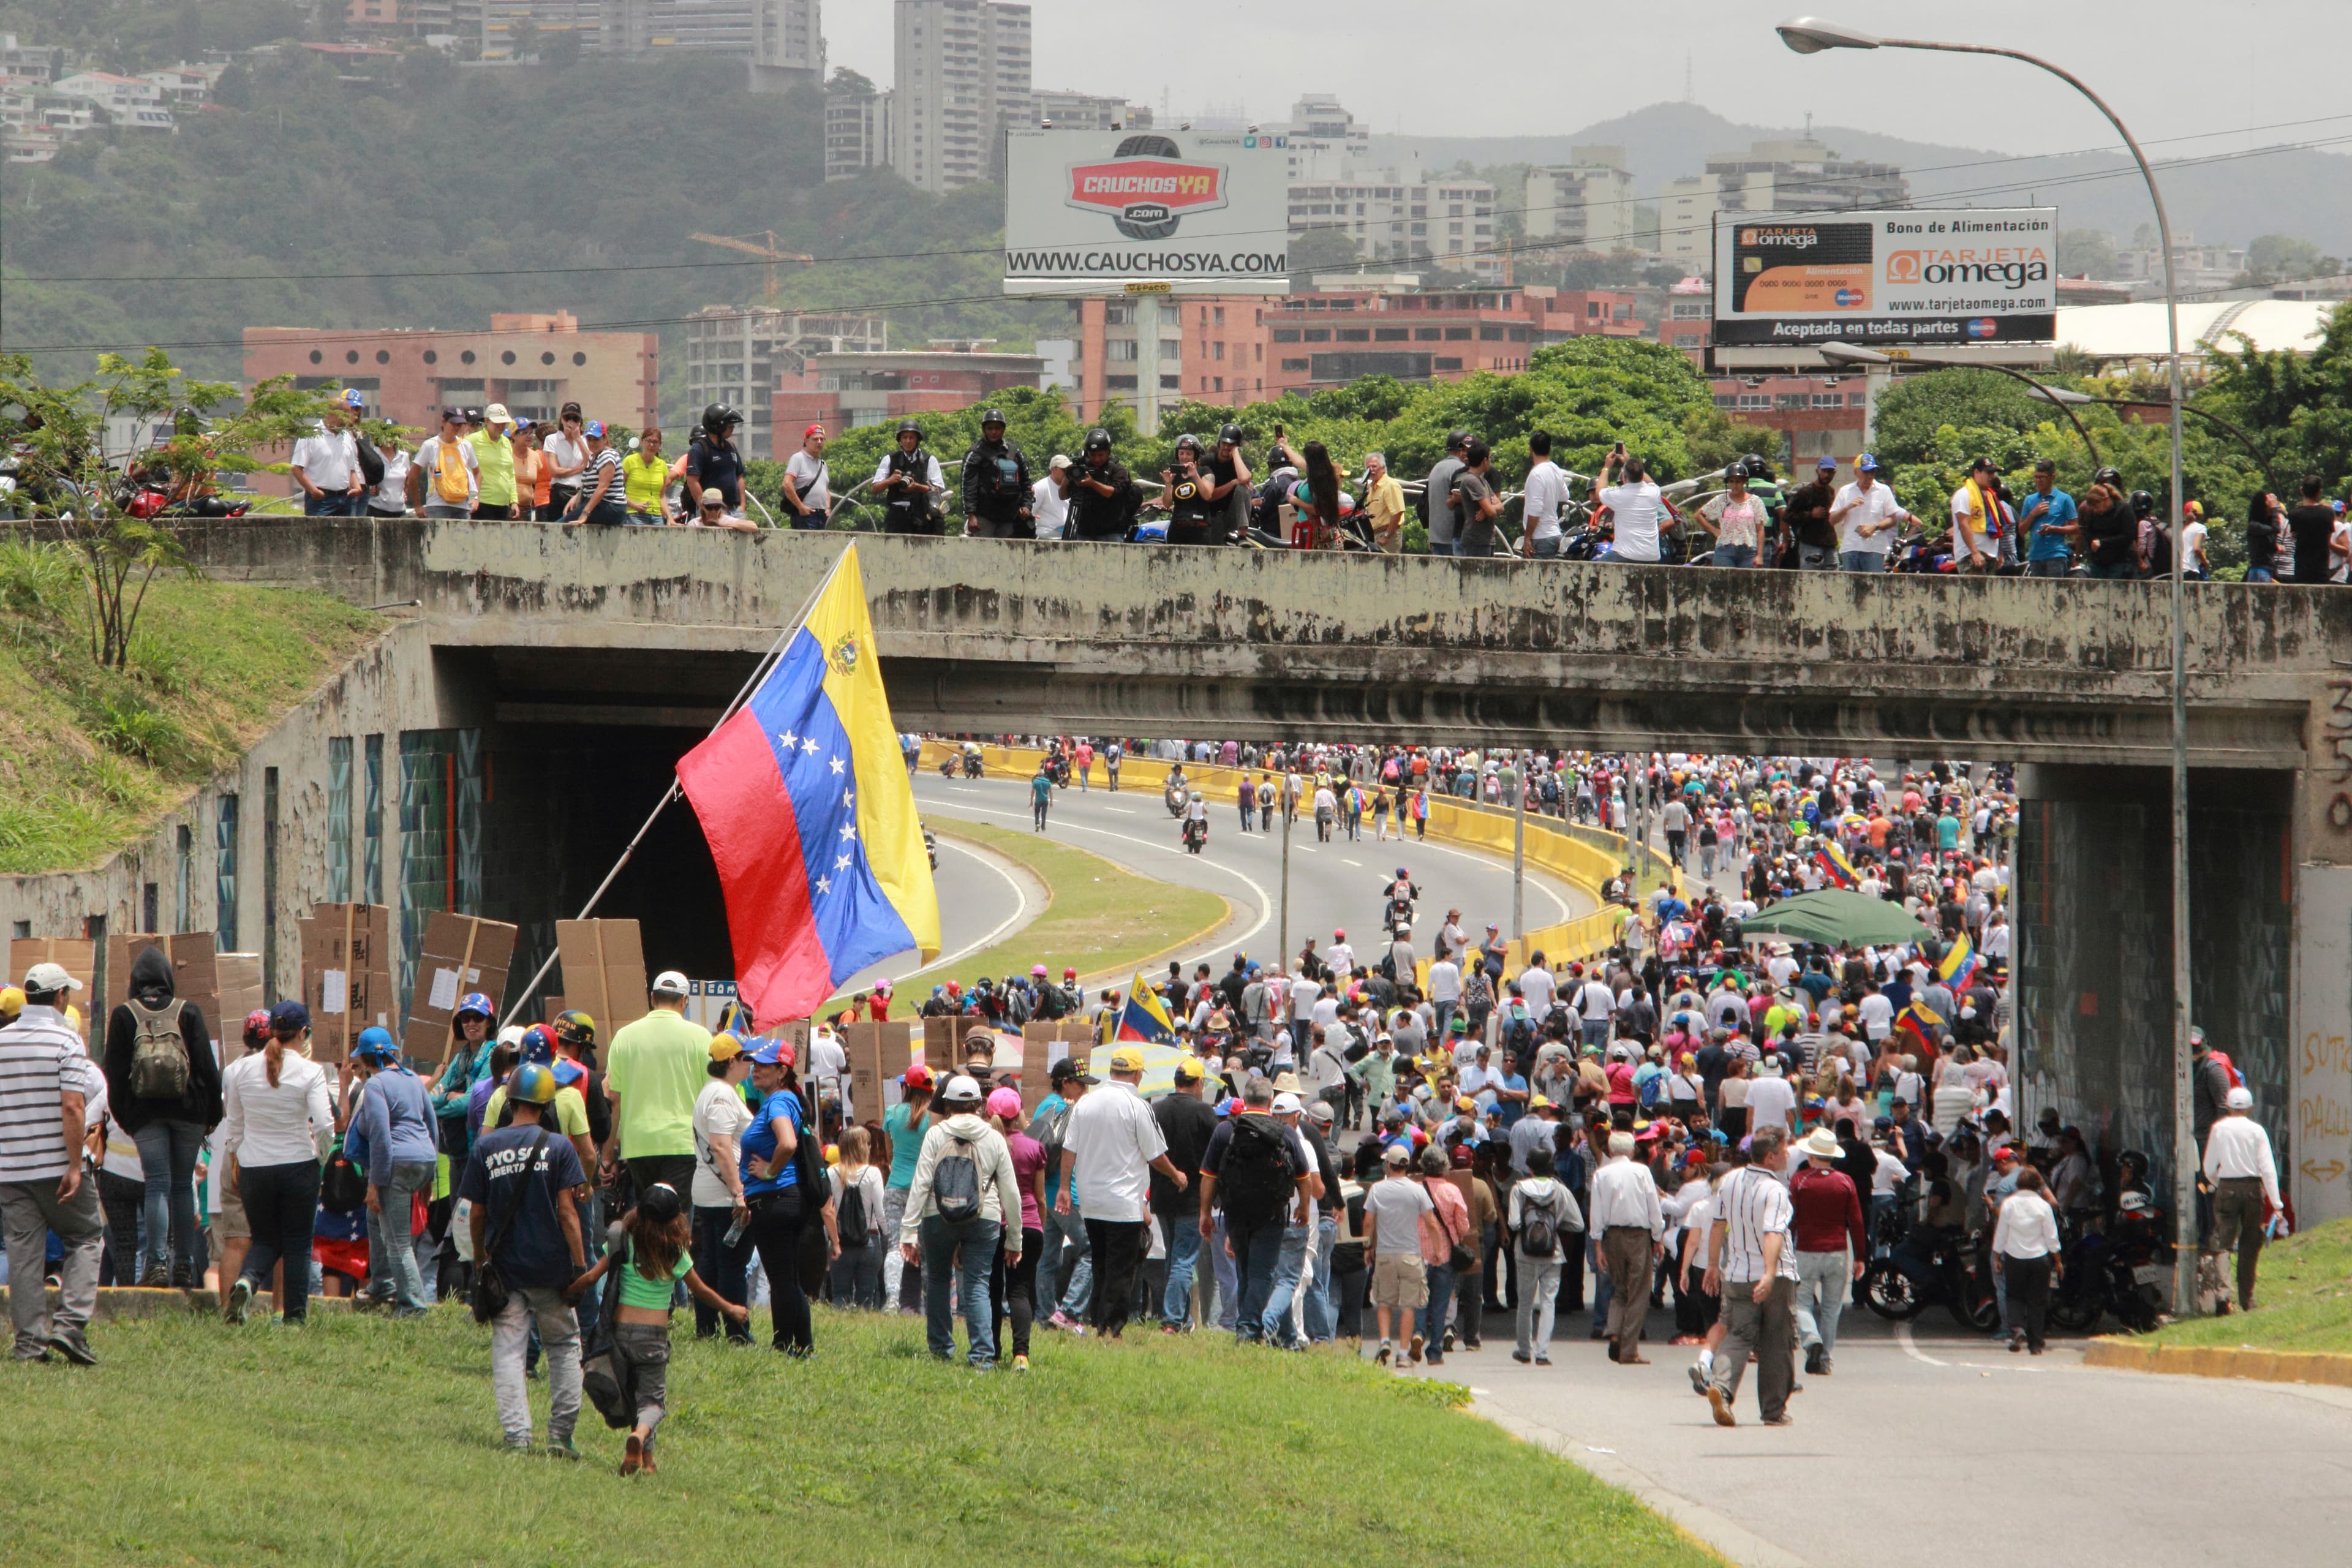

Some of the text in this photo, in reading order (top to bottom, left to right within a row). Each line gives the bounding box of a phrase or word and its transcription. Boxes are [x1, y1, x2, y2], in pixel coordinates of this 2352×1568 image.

[1084, 176, 1210, 194] CAUCHOSYA
[1129, 209, 1163, 218] .com
[1887, 219, 2049, 233] Bono de Alimentación
[1758, 235, 1819, 249] omega
[1007, 252, 1286, 273] WWW.CAUCHOSYA.COM
[1923, 247, 2047, 263] TARJETA
[1924, 262, 2048, 290] omega
[1889, 297, 2046, 313] www.tarjetaomega.com
[1773, 320, 1959, 338] Aceptada en todas partes
[485, 1149, 516, 1170] #YO
[489, 1161, 549, 1180] LIBERTAOR
